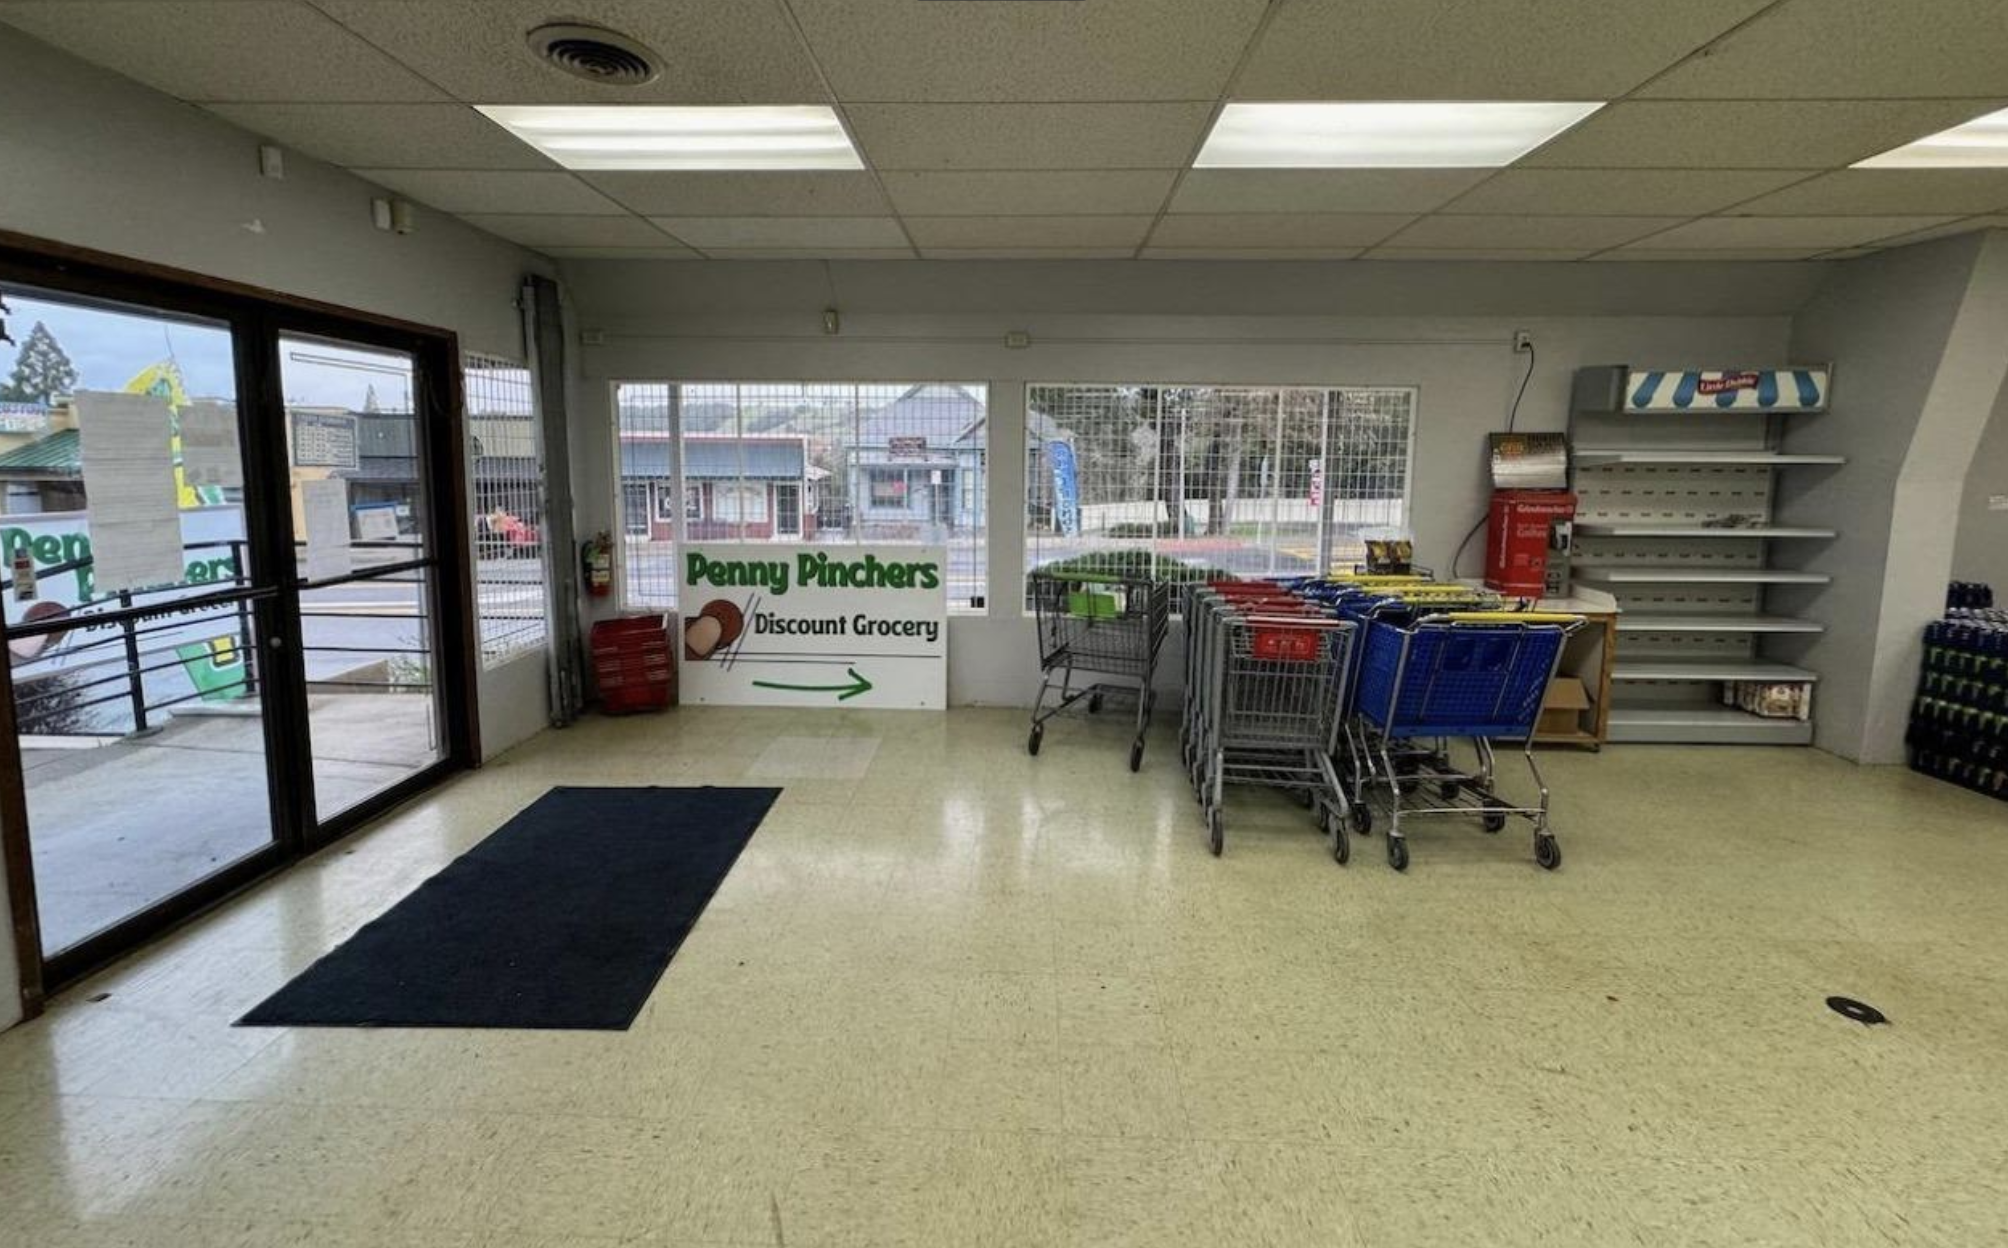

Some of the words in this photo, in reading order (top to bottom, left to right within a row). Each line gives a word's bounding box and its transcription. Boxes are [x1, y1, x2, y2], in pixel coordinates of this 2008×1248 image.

[0, 527, 93, 568] Pen
[686, 552, 790, 596] Penny
[797, 551, 940, 590] Pinchers
[755, 612, 847, 637] Discount
[853, 614, 940, 643] Grocery
